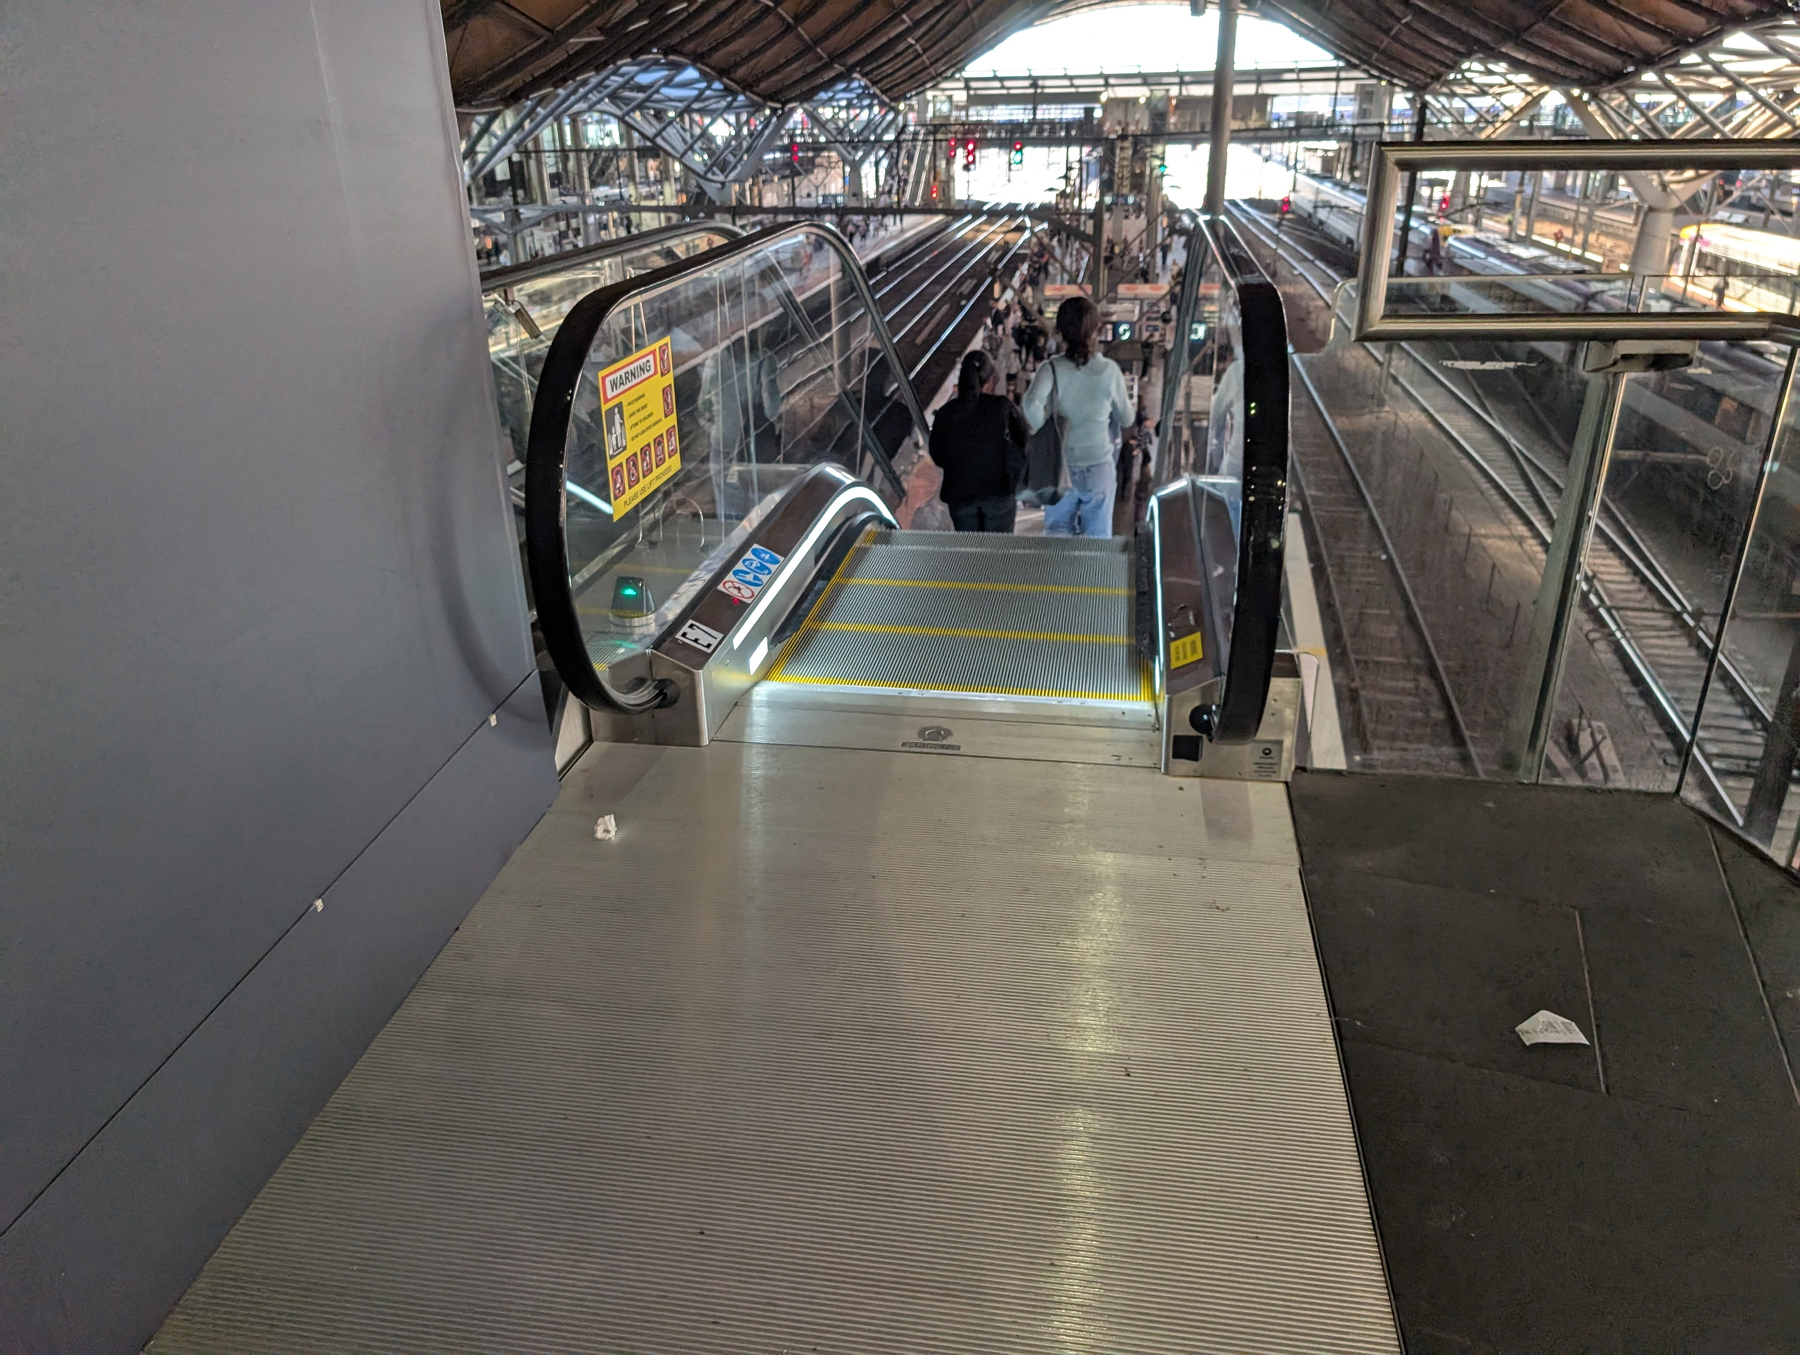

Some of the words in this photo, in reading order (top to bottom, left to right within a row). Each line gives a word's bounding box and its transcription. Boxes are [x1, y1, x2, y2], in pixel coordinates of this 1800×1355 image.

[609, 359, 652, 393] WARNING
[624, 491, 639, 508] PLEASE
[647, 478, 655, 489] LIFT
[655, 465, 672, 481] PROVIDED
[680, 622, 718, 650] E7
